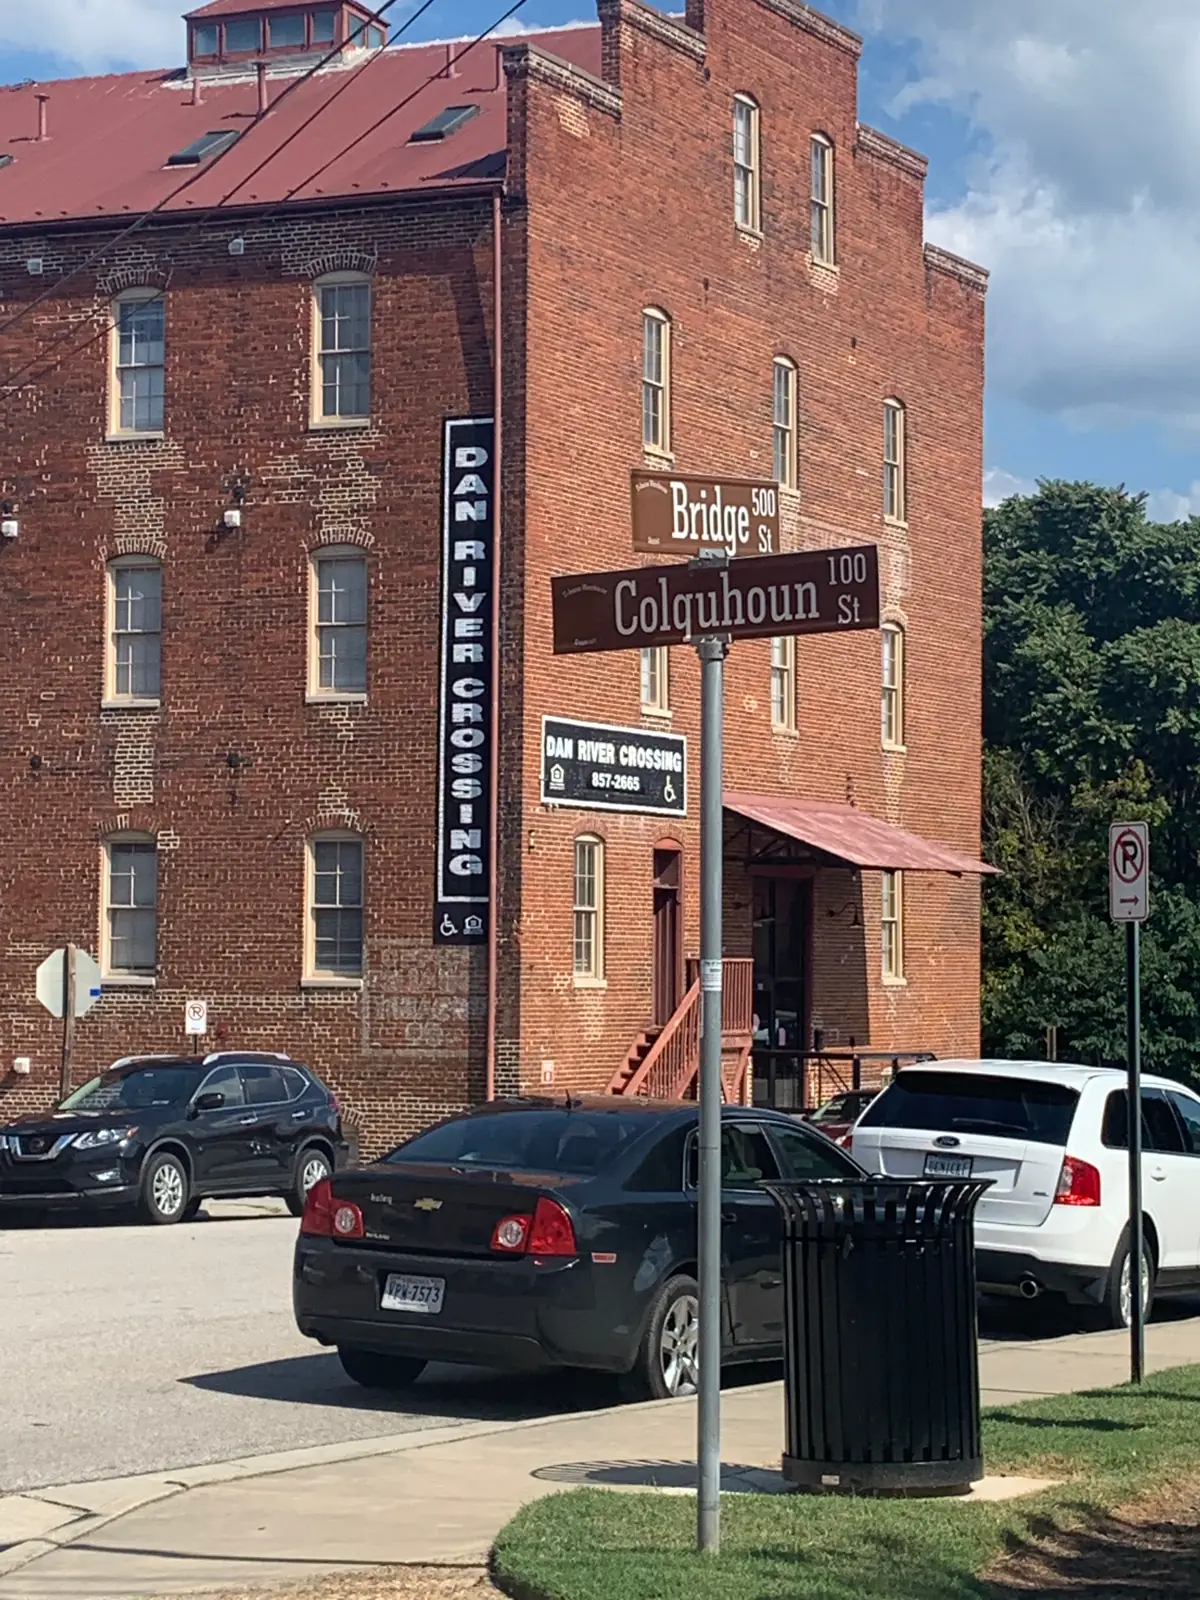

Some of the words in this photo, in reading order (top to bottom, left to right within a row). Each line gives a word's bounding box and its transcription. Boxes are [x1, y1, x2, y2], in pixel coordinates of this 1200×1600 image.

[453, 447, 488, 521] DAN
[671, 482, 749, 556] Bridge
[758, 524, 773, 553] St
[752, 488, 775, 517] 500
[452, 540, 486, 663] RIVER
[829, 553, 867, 585] 100
[614, 571, 820, 642] Colquhoun
[837, 594, 860, 624] St
[449, 677, 485, 876] CROSSING
[546, 735, 573, 759] DAN
[577, 740, 615, 764] RIVER
[619, 745, 682, 772] CROSSING
[591, 772, 640, 791] 857-2665
